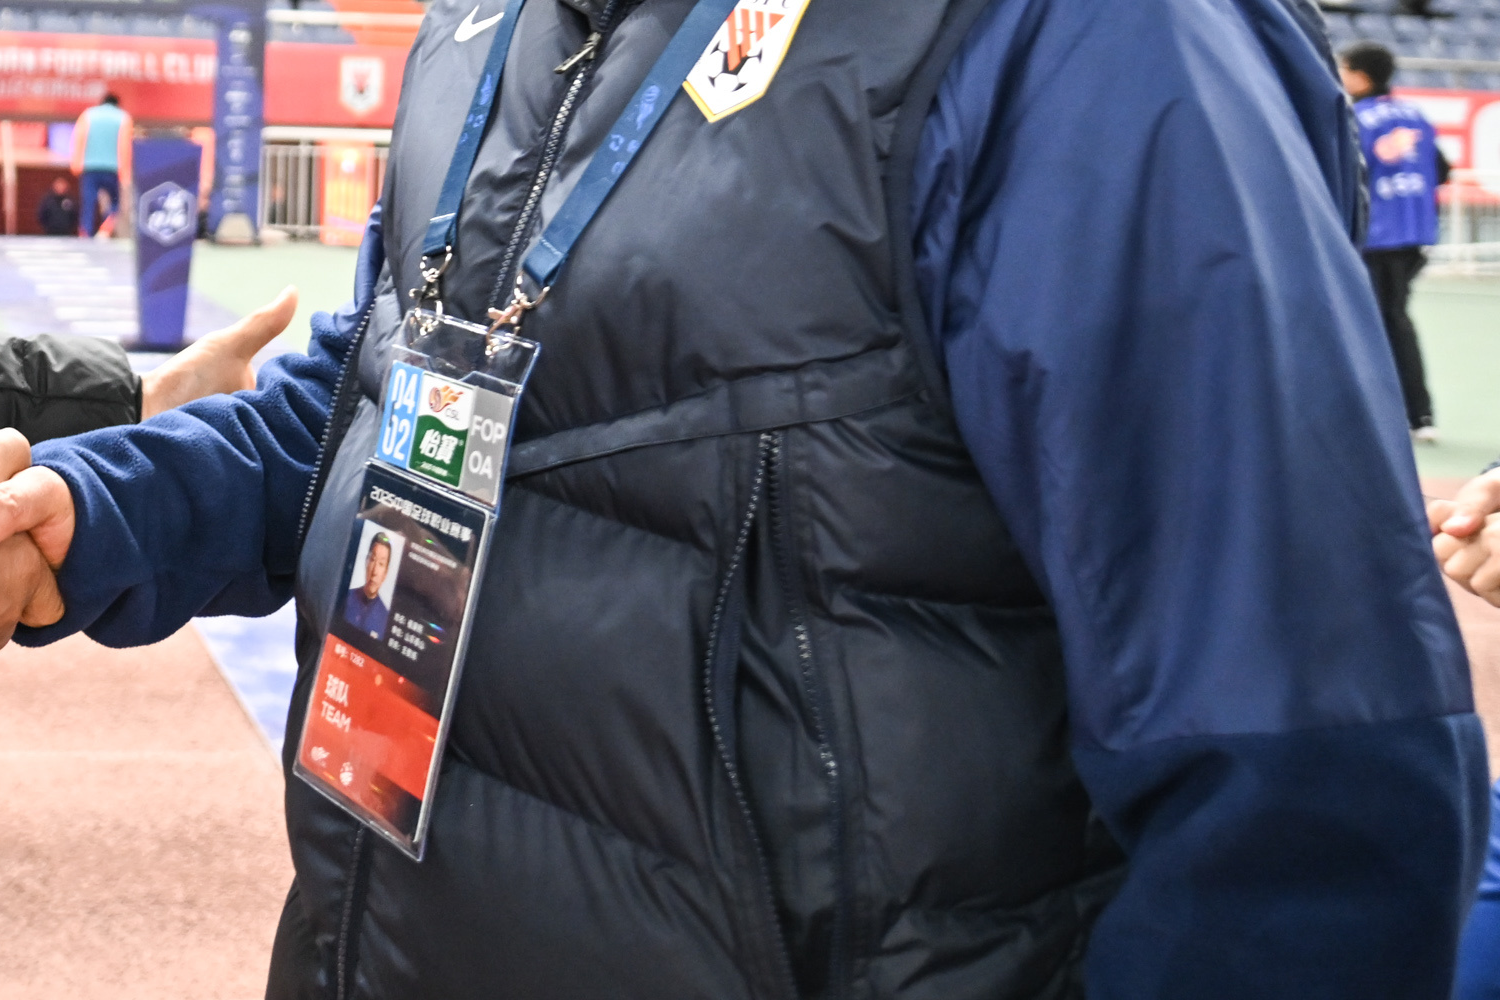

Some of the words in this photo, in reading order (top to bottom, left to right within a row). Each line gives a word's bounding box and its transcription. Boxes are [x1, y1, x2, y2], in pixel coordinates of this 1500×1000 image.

[392, 369, 418, 414] 04
[382, 415, 411, 461] 02
[470, 414, 506, 444] FOP
[468, 450, 494, 480] OA
[320, 700, 352, 733] TEAM
